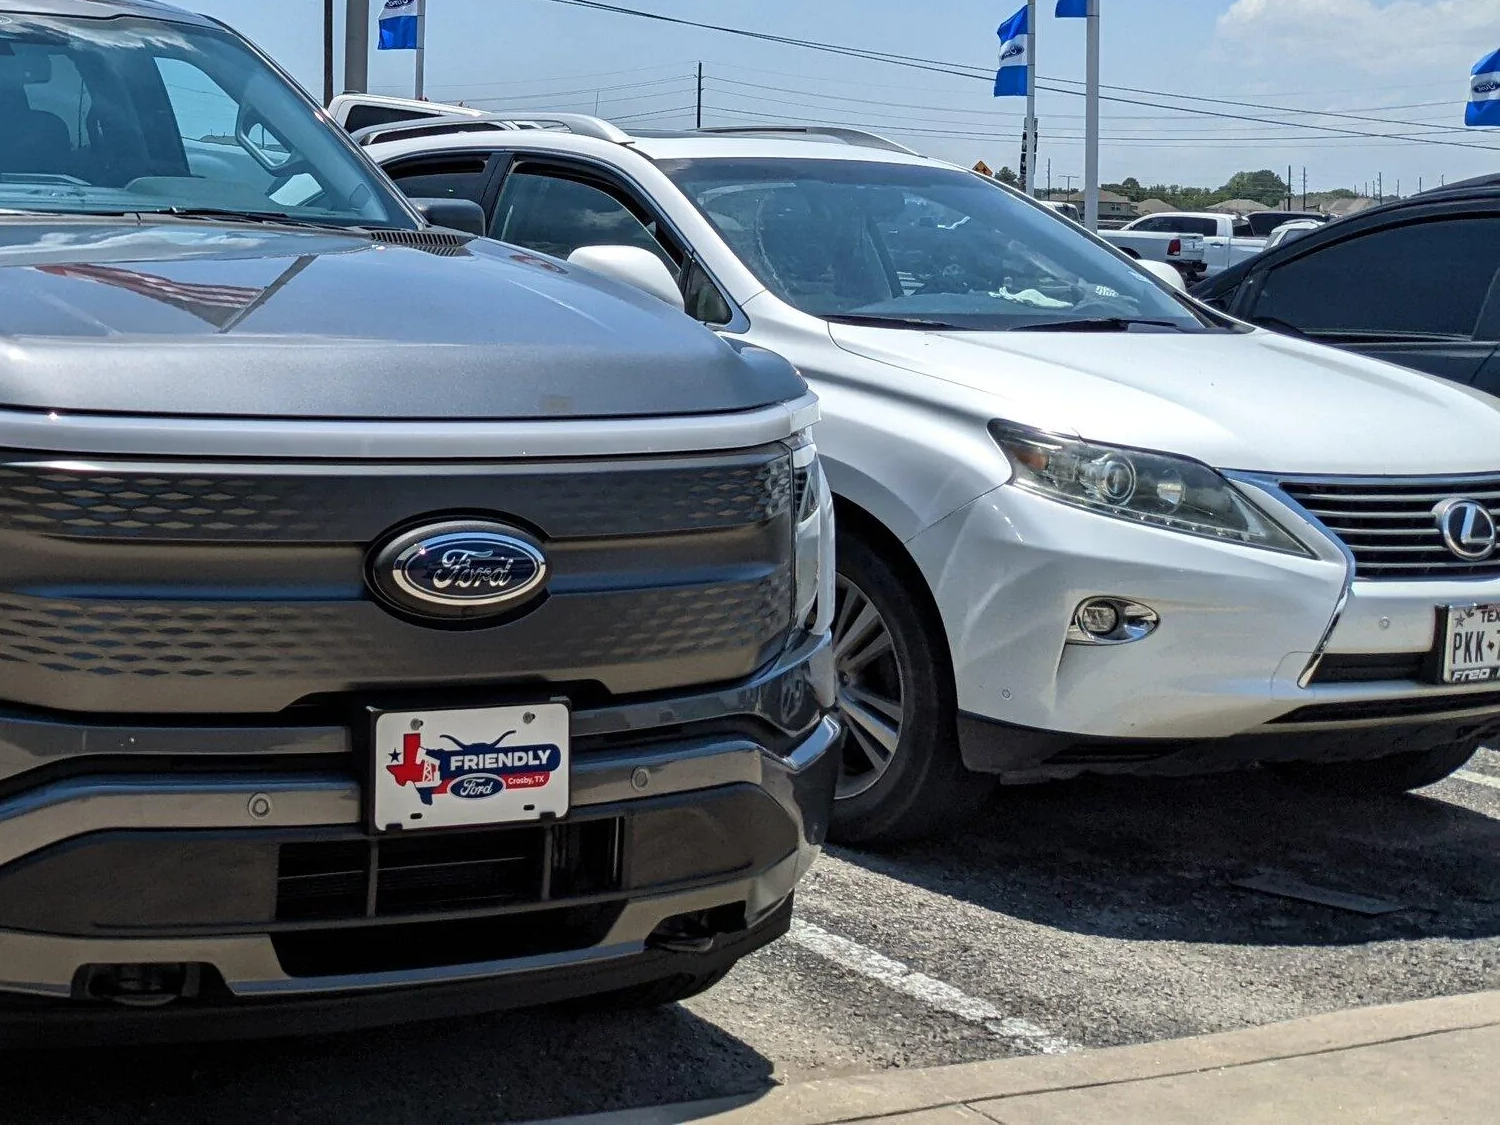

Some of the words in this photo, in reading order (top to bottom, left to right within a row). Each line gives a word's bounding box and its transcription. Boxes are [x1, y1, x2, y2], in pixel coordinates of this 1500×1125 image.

[432, 548, 514, 589] Ford
[449, 749, 552, 772] FRIENDLY
[460, 777, 494, 797] Ford
[507, 776, 535, 785] Crosby,
[535, 775, 545, 783] TX
